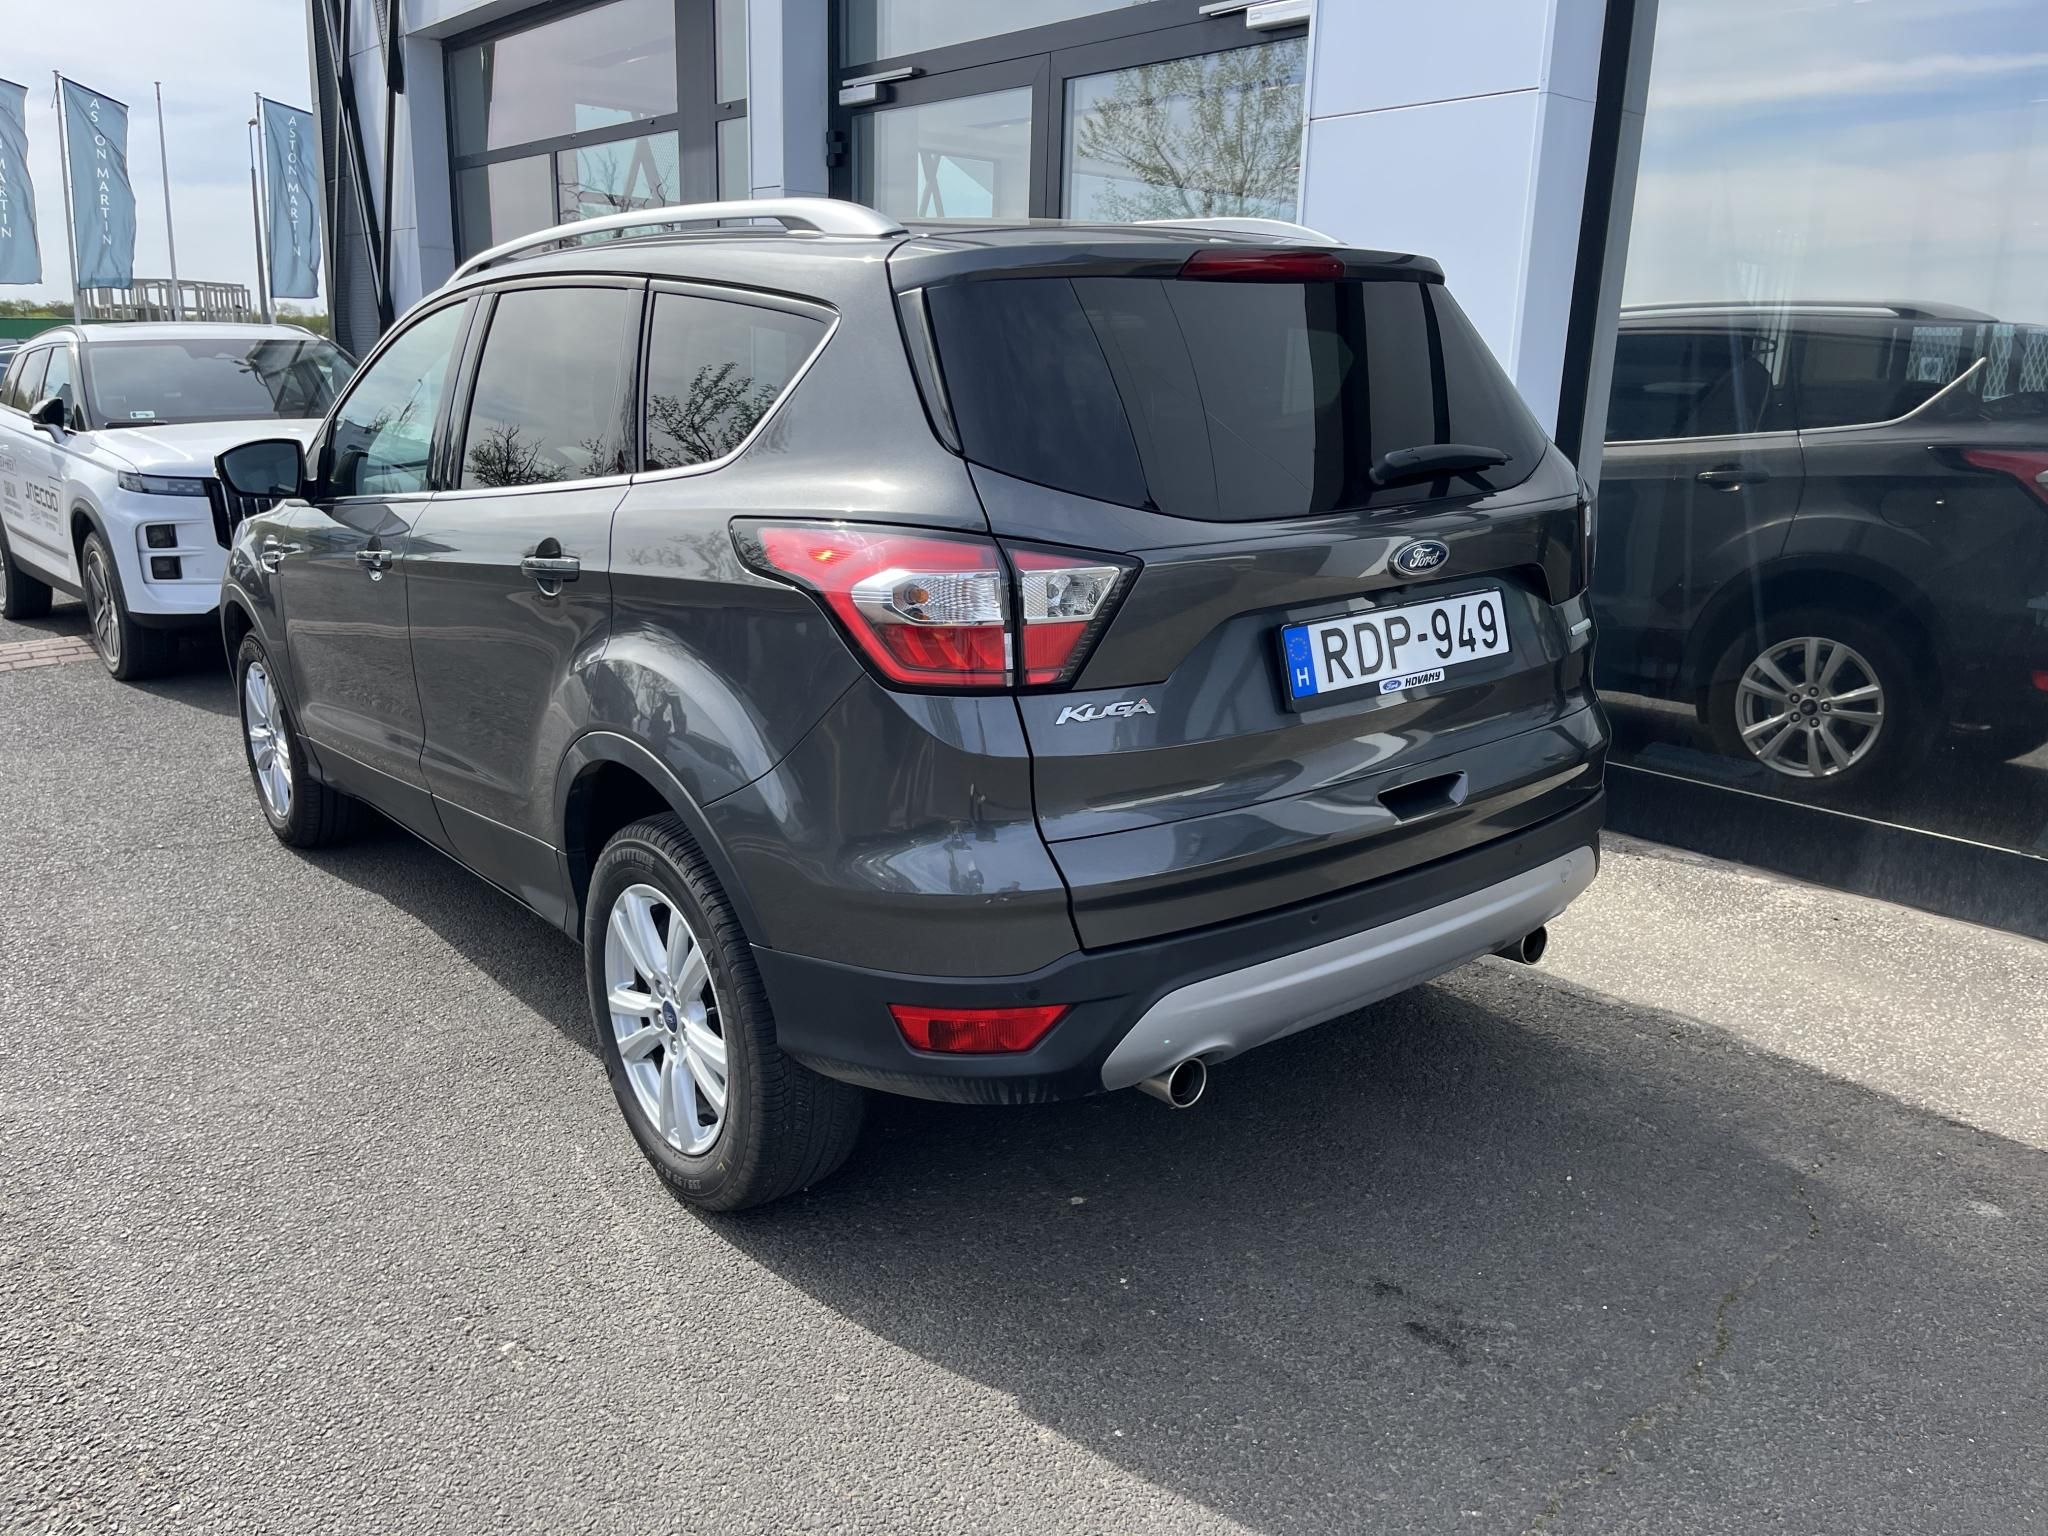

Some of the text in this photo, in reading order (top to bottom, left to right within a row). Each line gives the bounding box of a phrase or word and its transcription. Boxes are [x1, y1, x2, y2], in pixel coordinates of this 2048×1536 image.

[89, 98, 112, 246] ASON MARTIN
[287, 116, 301, 257] ASTON MARTIN
[1409, 546, 1440, 568] Ford
[1297, 600, 1498, 688] H RDP-949
[1055, 698, 1156, 725] KUGA
